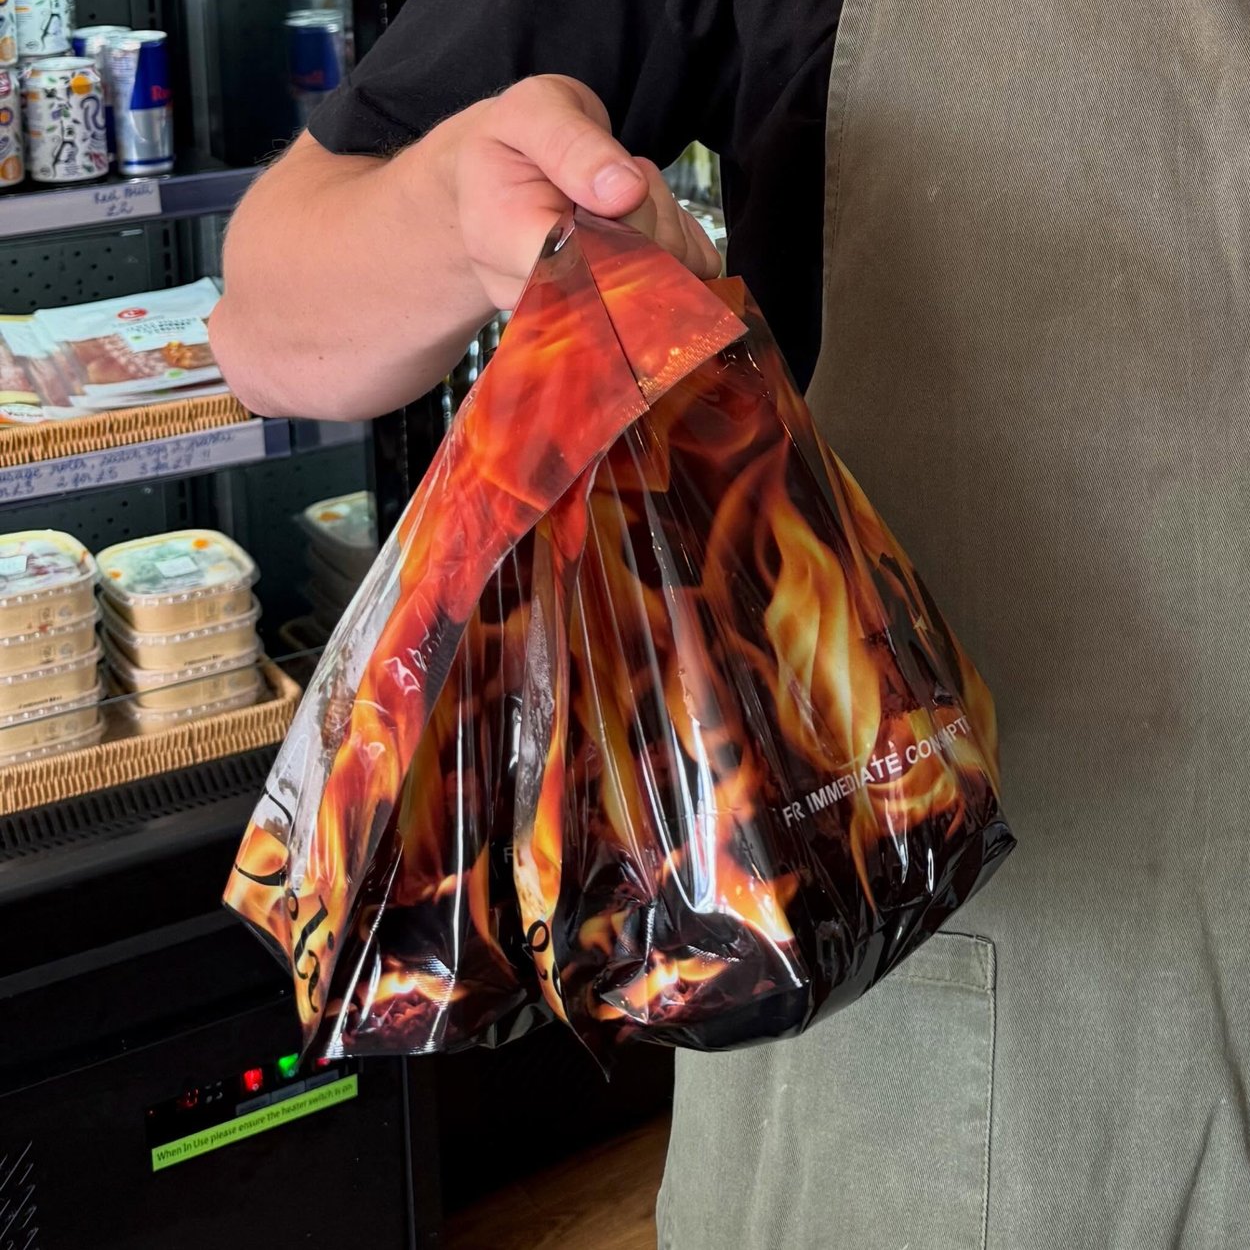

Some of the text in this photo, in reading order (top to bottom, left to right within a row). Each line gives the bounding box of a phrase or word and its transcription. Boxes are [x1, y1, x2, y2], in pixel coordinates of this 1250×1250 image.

[806, 752, 902, 814] IMMEDIATE
[157, 1147, 182, 1162] When
[183, 1142, 193, 1154] In
[193, 1134, 209, 1148] Use
[210, 1126, 237, 1145] please
[238, 1116, 265, 1132] ensure
[266, 1110, 280, 1123] the
[280, 1101, 308, 1117] heater
[307, 1092, 334, 1108] switch
